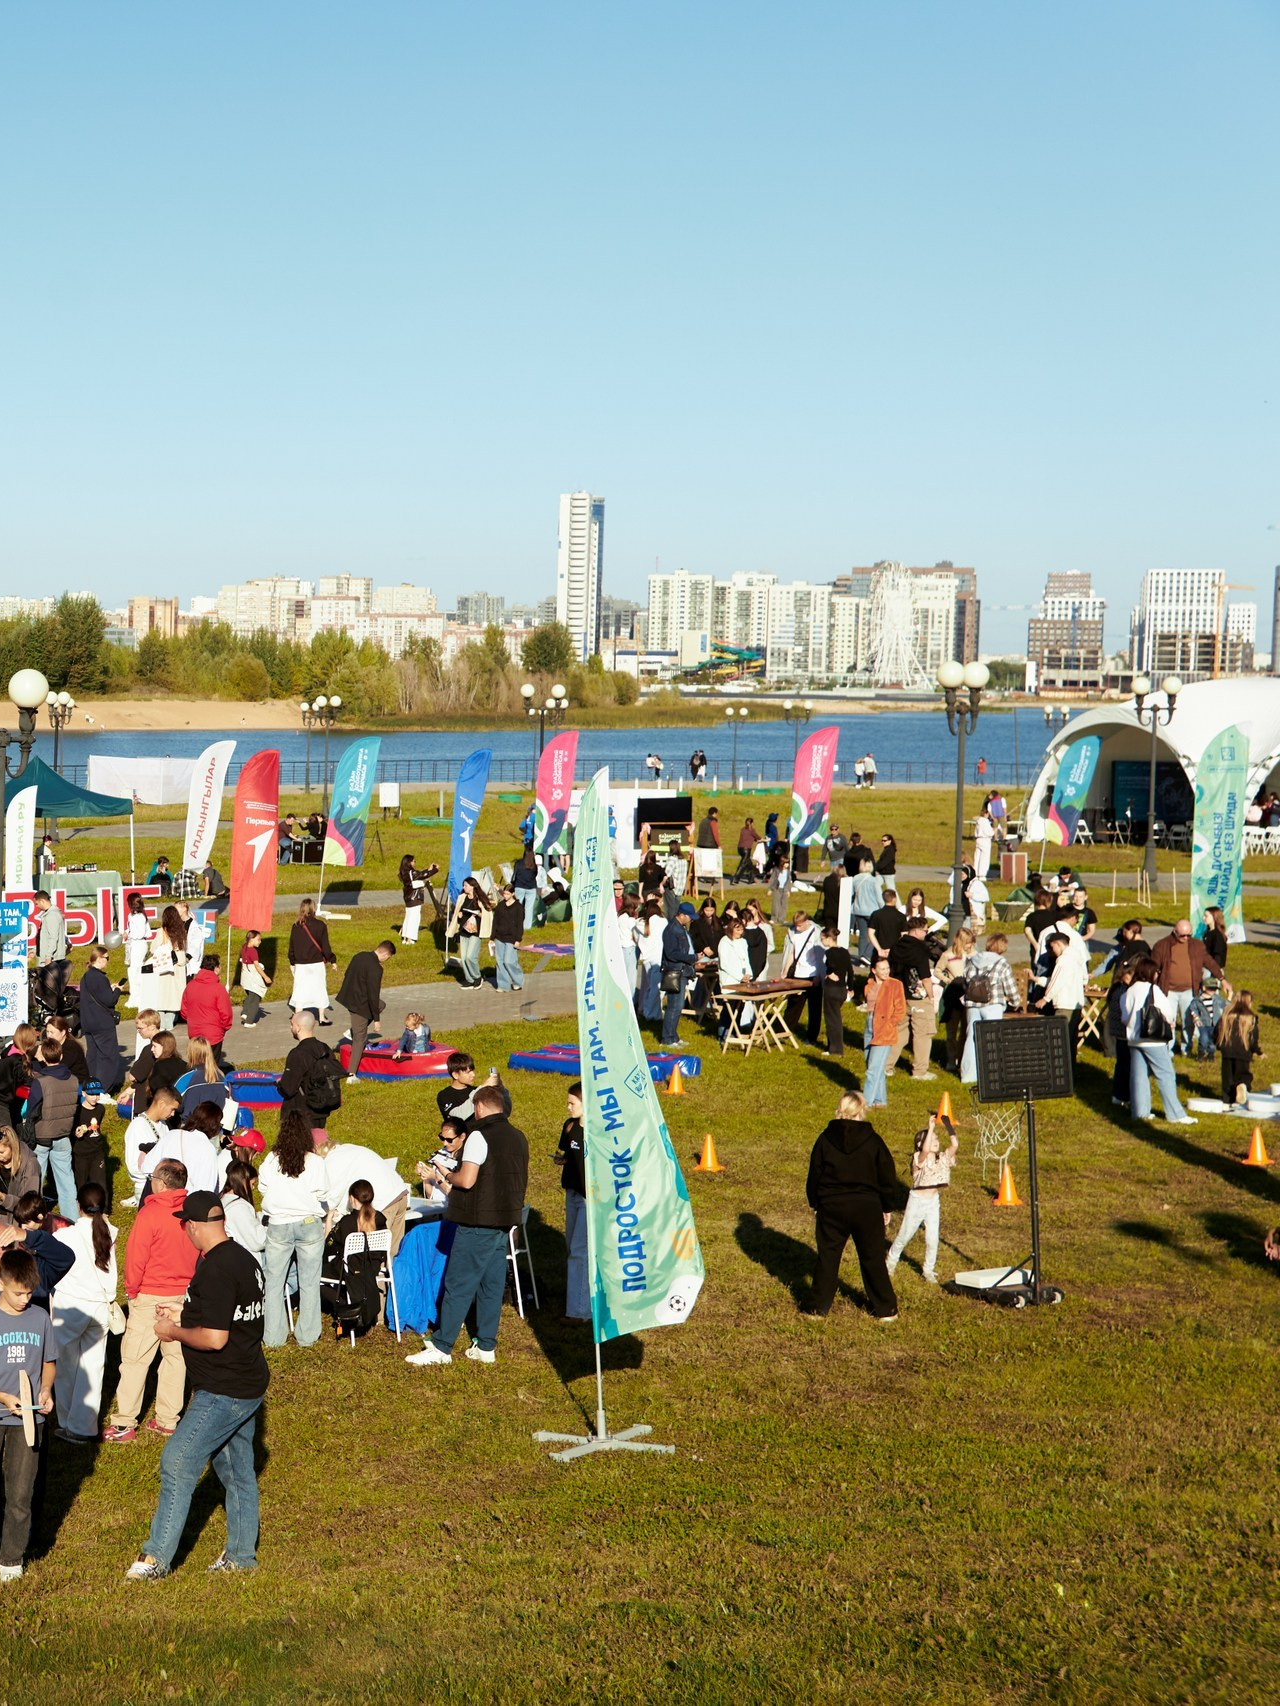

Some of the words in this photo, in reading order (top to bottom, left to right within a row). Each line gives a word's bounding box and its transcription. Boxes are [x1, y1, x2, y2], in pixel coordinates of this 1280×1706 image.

[190, 757, 216, 859] АЛДЫНГЫЛАР
[1224, 832, 1233, 851] БЕЗ
[4, 909, 22, 917] ТАМ,
[4, 918, 18, 926] ТЫ!
[588, 1020, 610, 1080] ТАМ,
[596, 1087, 625, 1132] МЫ
[609, 1147, 647, 1293] ПОДРОСТОК
[7, 1345, 26, 1358] 1981
